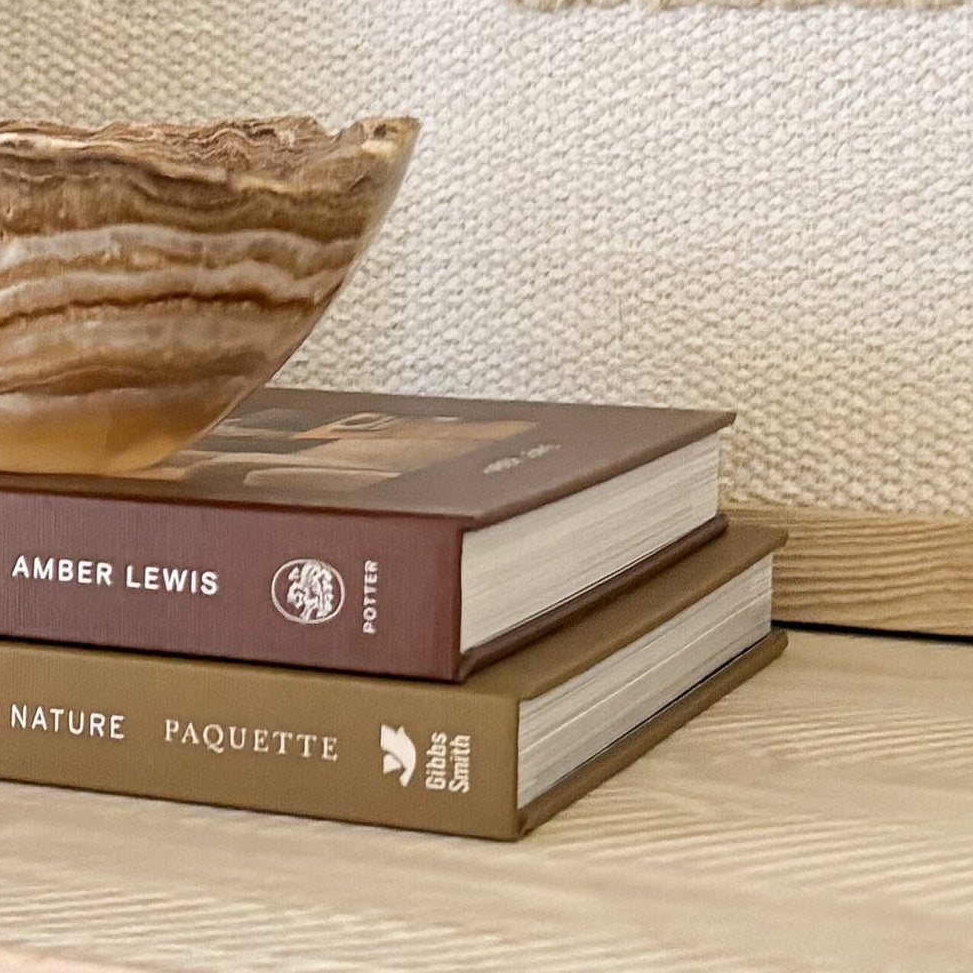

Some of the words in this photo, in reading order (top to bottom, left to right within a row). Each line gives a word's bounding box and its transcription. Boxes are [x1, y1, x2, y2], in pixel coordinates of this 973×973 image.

[11, 555, 113, 587] AMBER
[126, 564, 219, 596] LEWIS
[362, 559, 379, 635] POTTER
[10, 703, 125, 740] NATURE
[164, 718, 339, 762] PAQUETTE
[425, 731, 448, 790] Gibbs
[448, 734, 471, 794] Smith
